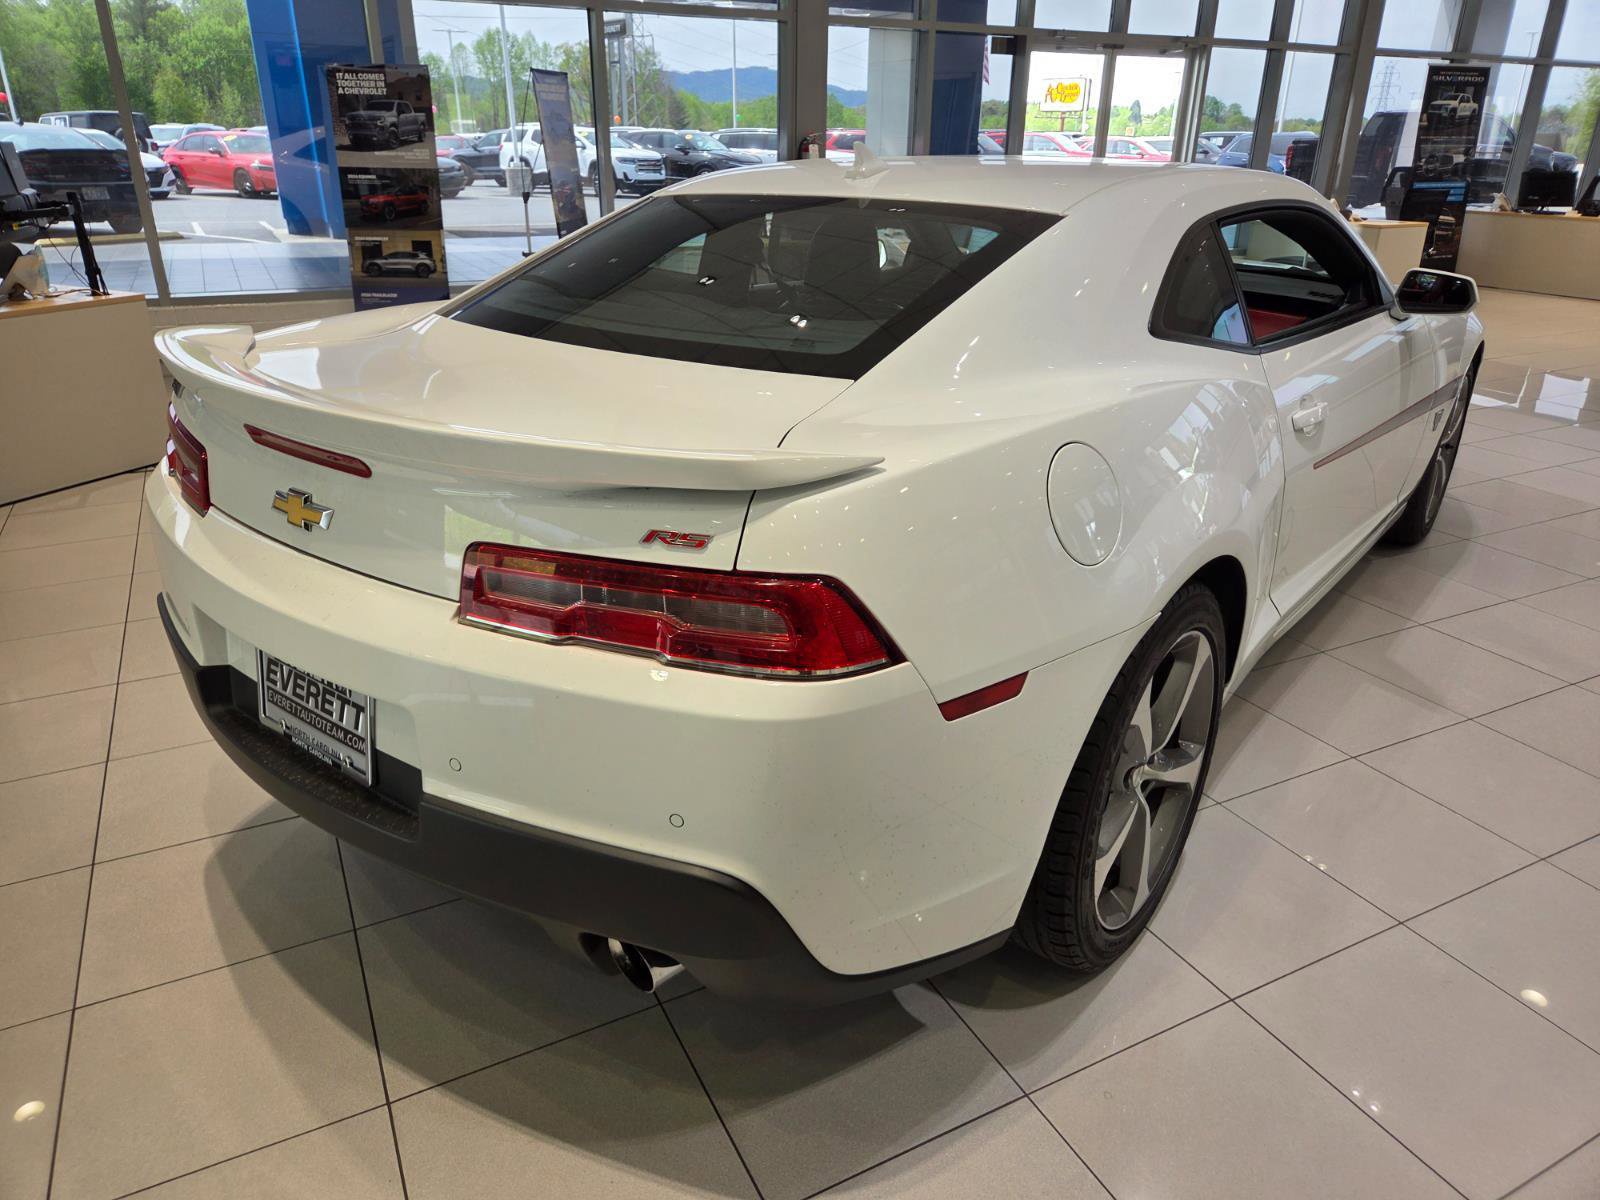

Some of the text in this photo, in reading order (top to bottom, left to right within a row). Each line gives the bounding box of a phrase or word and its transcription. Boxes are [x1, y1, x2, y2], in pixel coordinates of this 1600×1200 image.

[376, 80, 385, 88] IN
[639, 529, 714, 549] RS
[266, 657, 366, 733] EVERETT
[268, 689, 367, 753] EVERETTAUTOTEAM.COM
